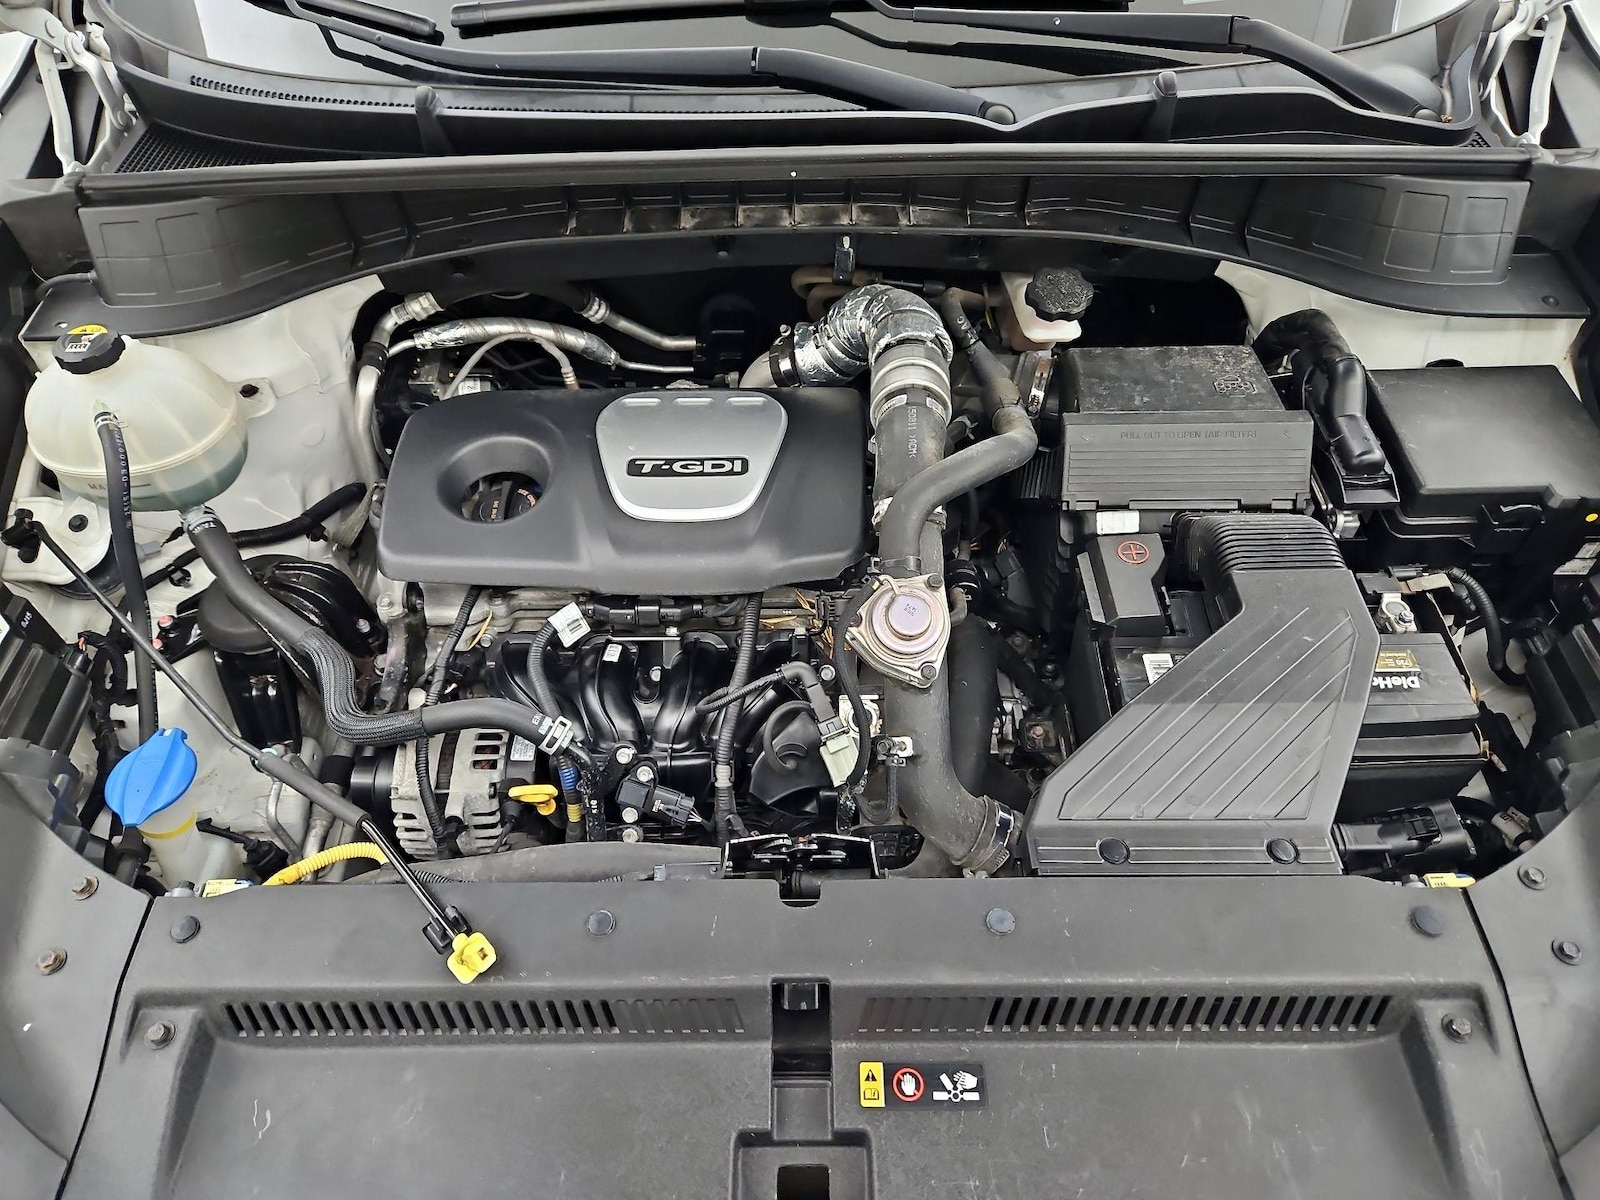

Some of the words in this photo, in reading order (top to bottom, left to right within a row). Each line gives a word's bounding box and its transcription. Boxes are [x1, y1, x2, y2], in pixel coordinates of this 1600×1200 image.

[1120, 431, 1141, 439] PULL
[1144, 431, 1161, 439] OUT
[1164, 431, 1175, 439] TO
[1177, 430, 1201, 439] OPEN
[635, 459, 743, 474] T-GDI
